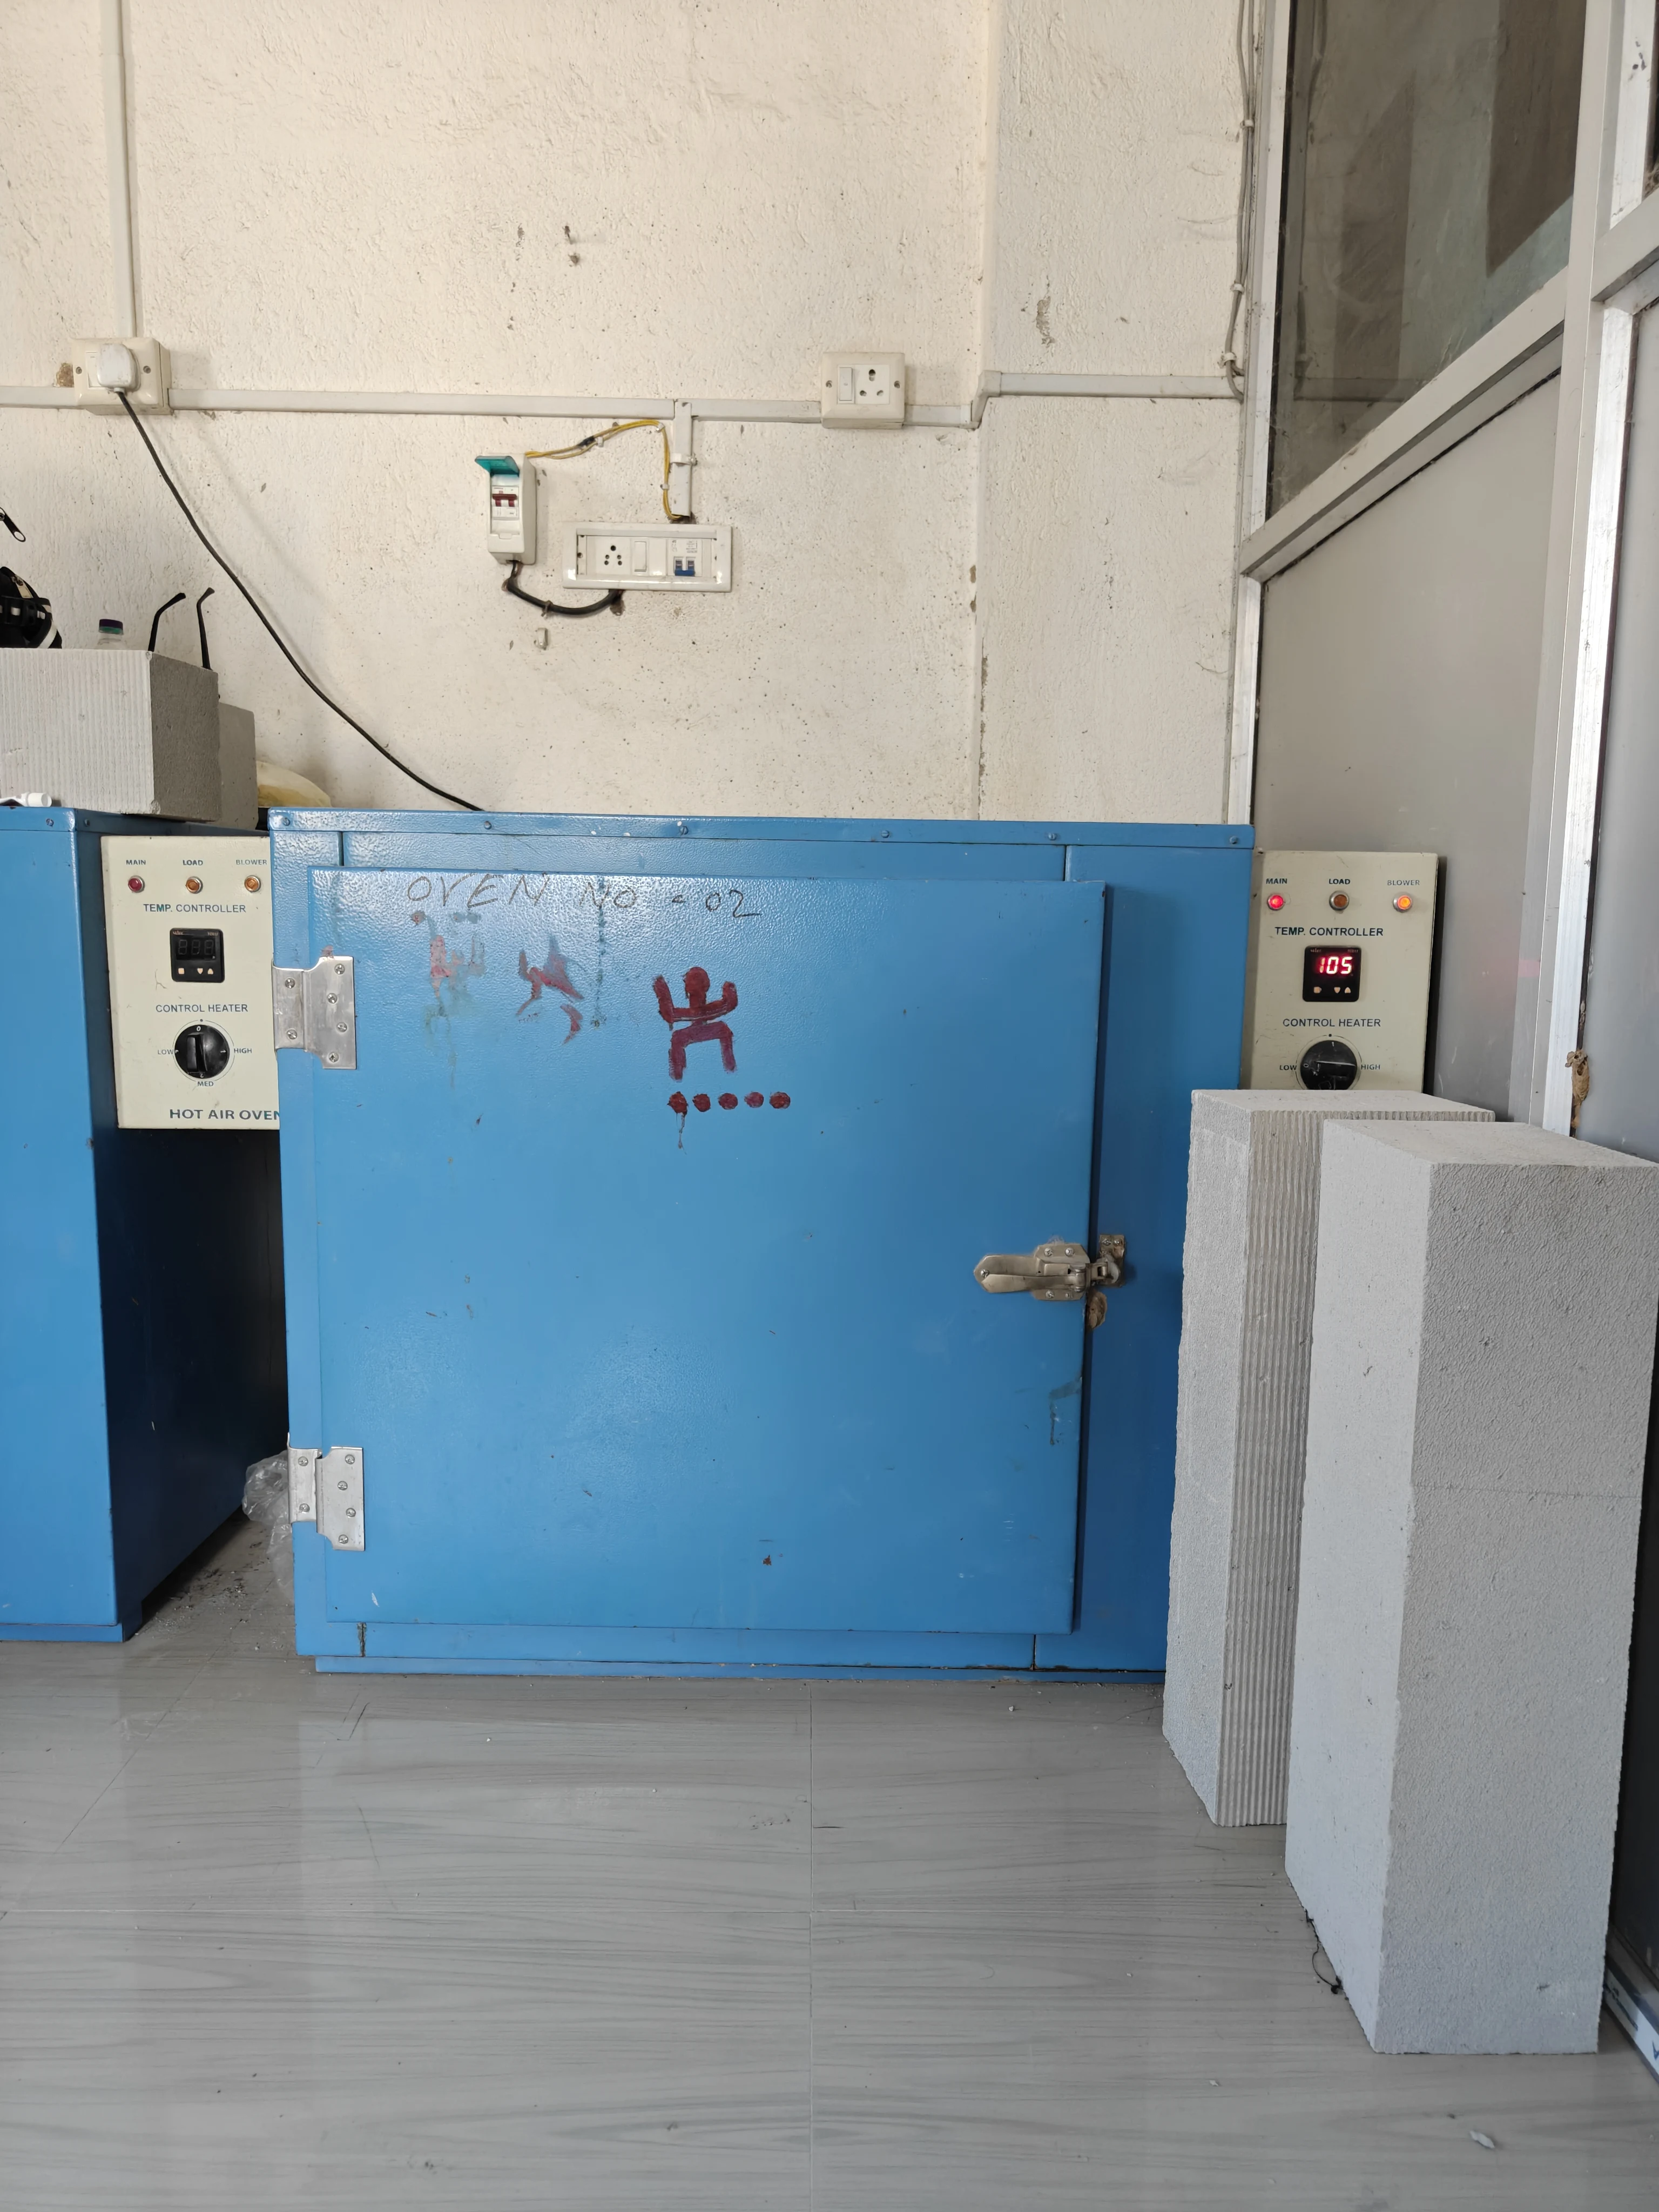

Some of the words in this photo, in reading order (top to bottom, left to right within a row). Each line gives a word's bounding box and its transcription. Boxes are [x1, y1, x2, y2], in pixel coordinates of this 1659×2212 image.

[407, 871, 550, 908] OVEN
[579, 881, 637, 909] NO
[705, 889, 761, 918] 02
[143, 903, 173, 912] TEMP.
[176, 904, 246, 913] CONTROLLER
[1274, 926, 1306, 936] TEMP.
[1309, 927, 1384, 936] CONTROLLER
[1319, 956, 1352, 974] 105
[156, 1004, 205, 1013] CONTROL
[208, 1004, 248, 1013] HEATER
[1283, 1018, 1336, 1027] CONTROL
[1338, 1019, 1381, 1027] HEATER
[170, 1109, 204, 1119] HOT
[208, 1110, 235, 1120] AIR
